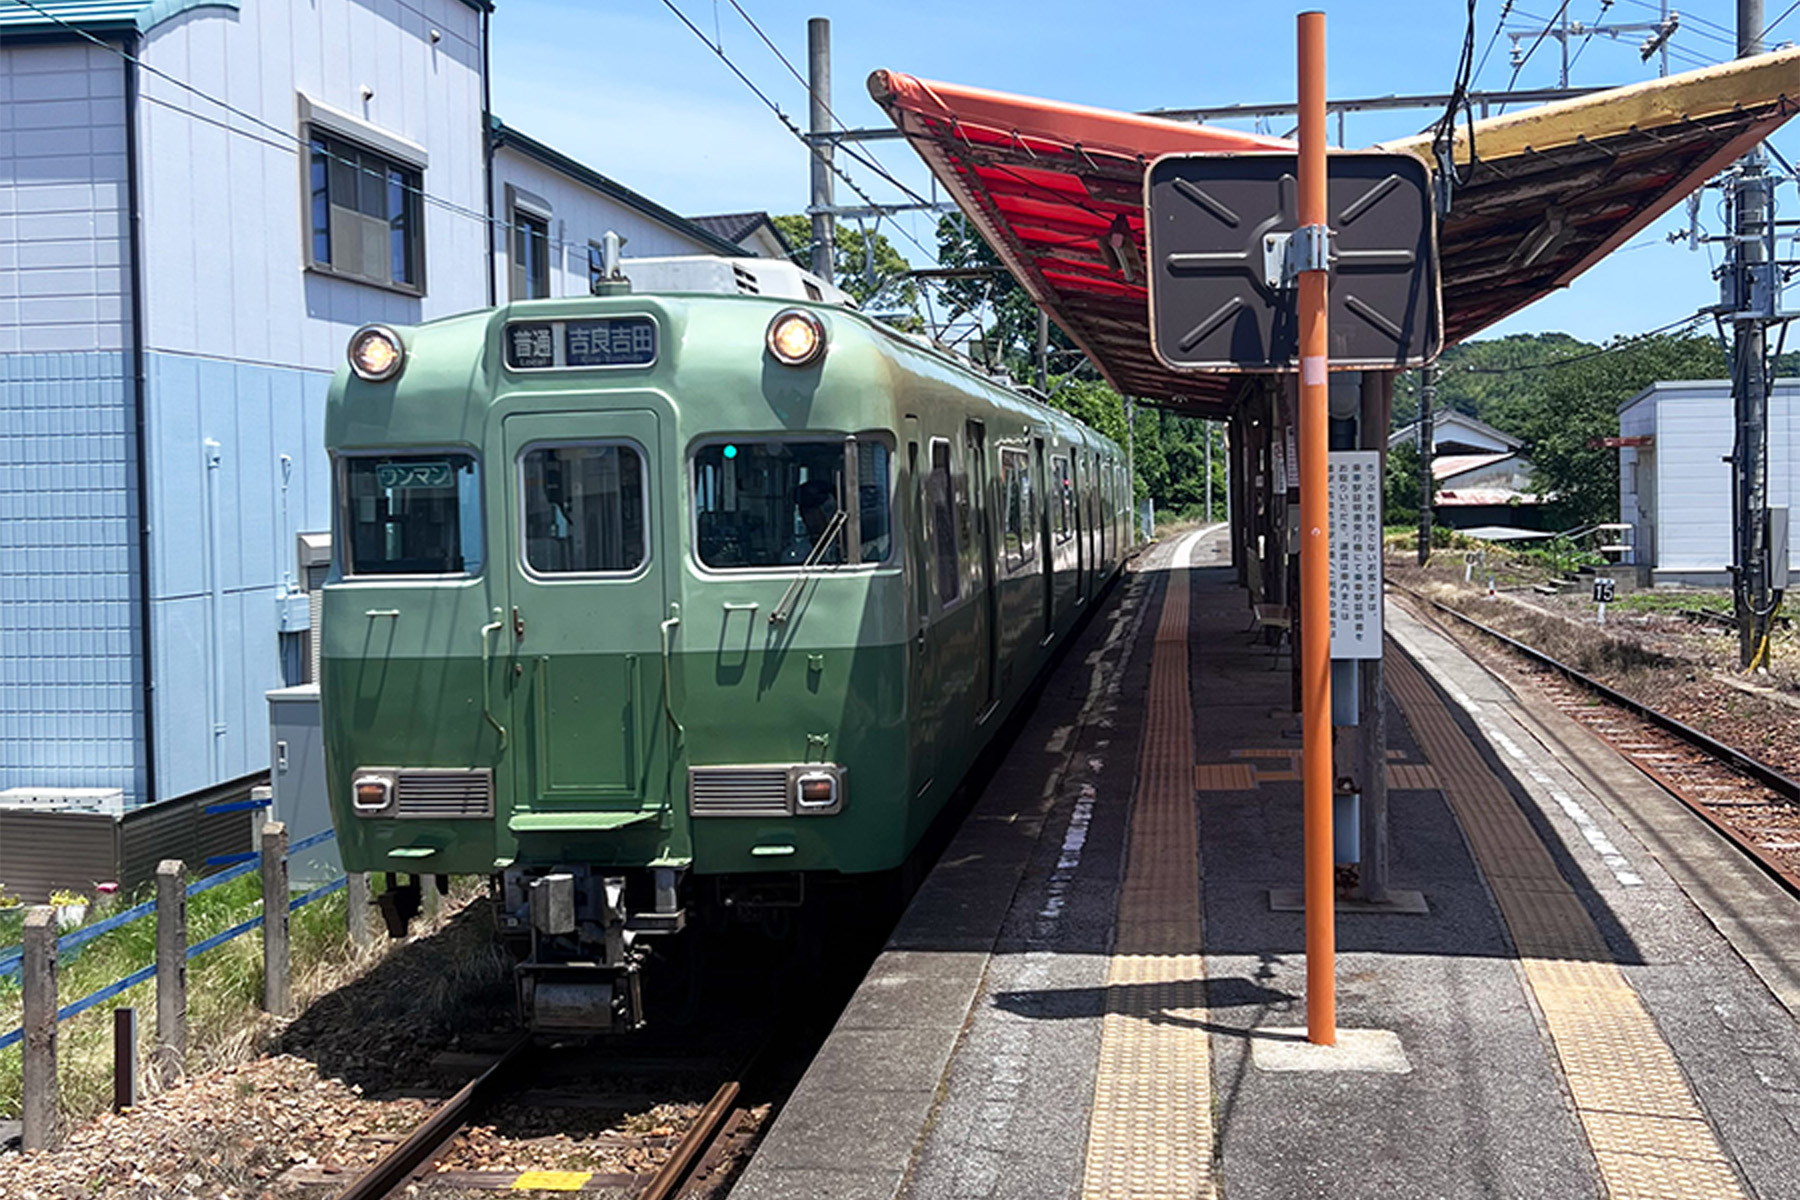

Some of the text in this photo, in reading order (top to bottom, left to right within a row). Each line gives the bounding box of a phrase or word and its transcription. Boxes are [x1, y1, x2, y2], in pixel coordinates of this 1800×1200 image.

[513, 329, 552, 357] 普通
[569, 325, 653, 355] 吉良吉田
[519, 358, 546, 366] Local
[381, 467, 449, 485] ワンマン
[1596, 584, 1613, 601] 15
